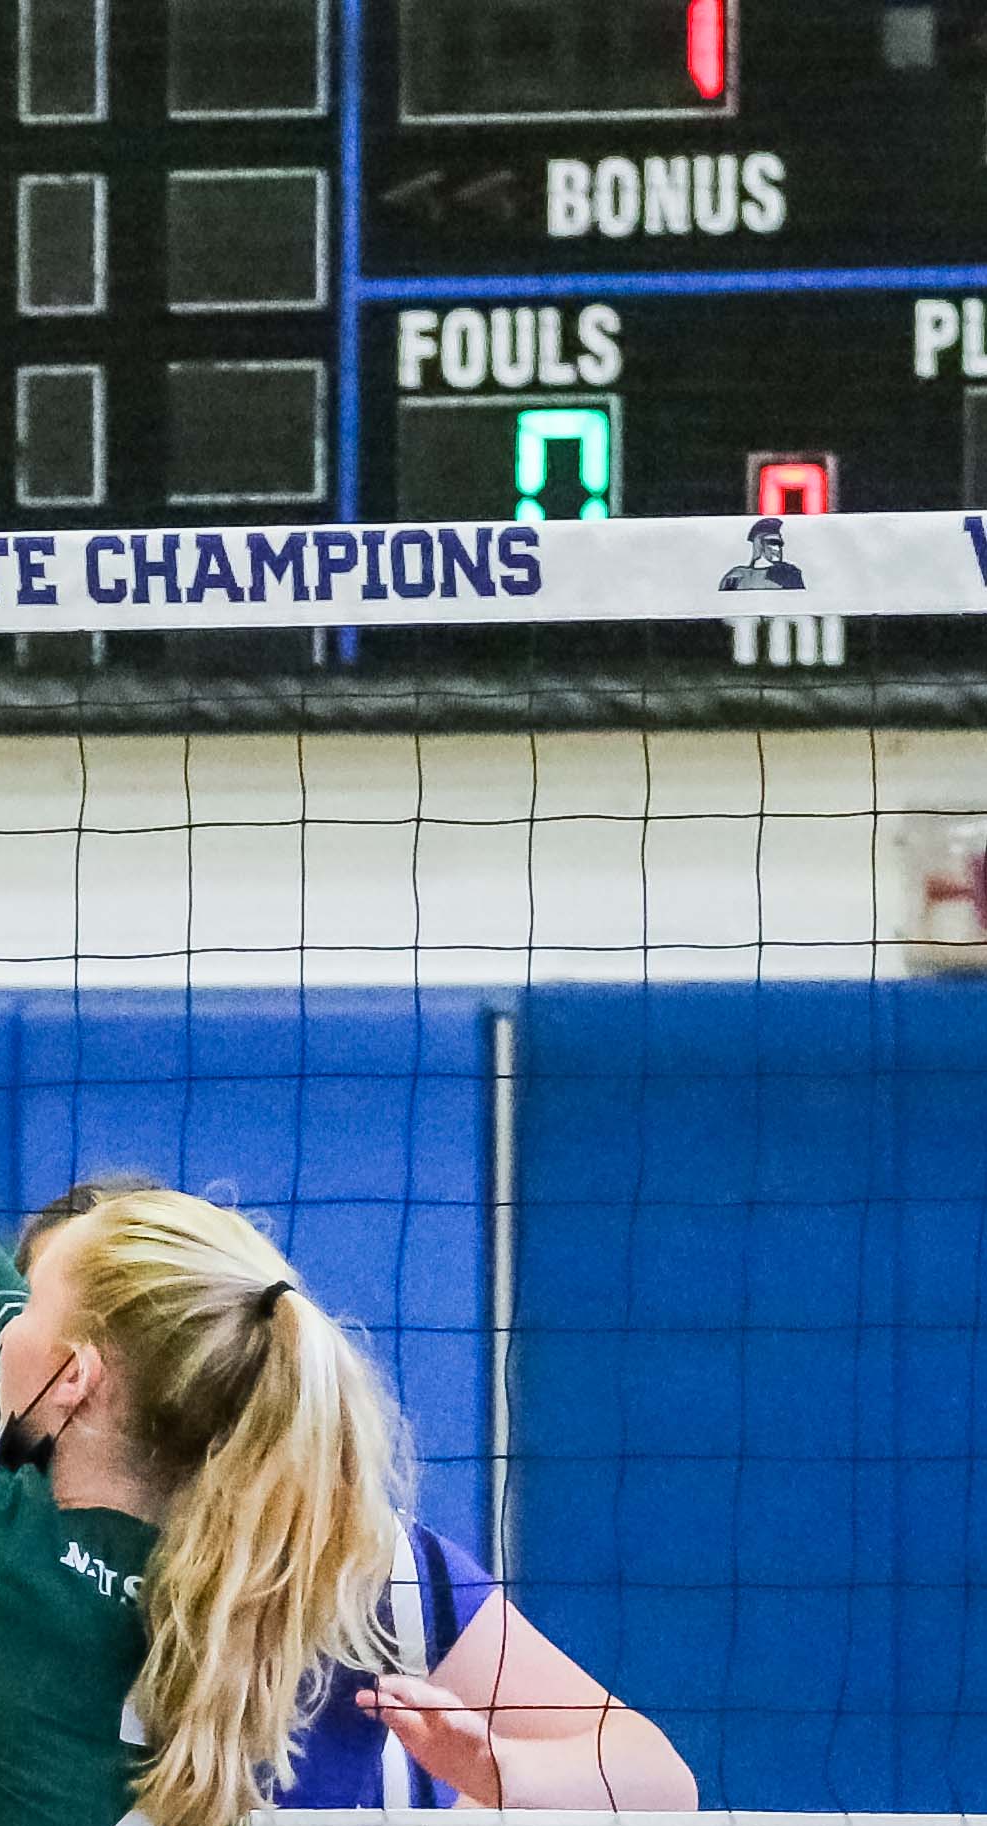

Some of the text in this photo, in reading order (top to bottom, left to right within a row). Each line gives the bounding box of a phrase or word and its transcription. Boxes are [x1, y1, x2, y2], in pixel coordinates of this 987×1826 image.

[547, 152, 786, 237] BONUS
[398, 304, 622, 389] FOULS
[914, 298, 987, 378] PL
[85, 526, 542, 605] CHAMPIONS
